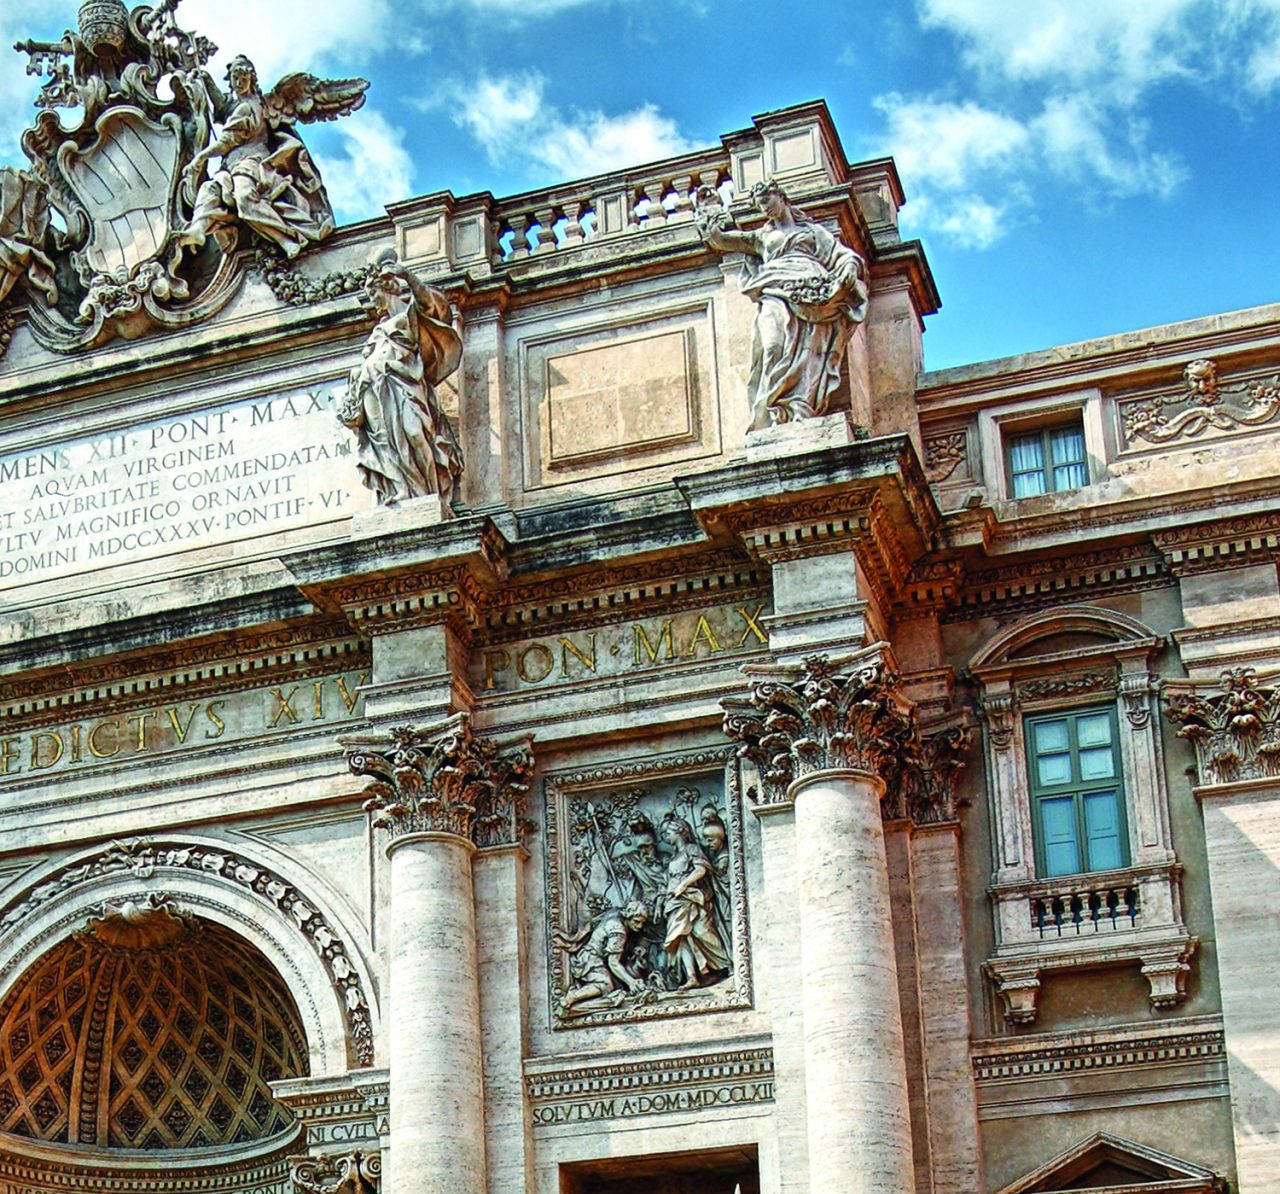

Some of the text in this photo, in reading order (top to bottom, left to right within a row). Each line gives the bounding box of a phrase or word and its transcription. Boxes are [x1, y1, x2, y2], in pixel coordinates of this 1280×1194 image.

[23, 480, 160, 525] SALVBRITATE
[172, 438, 353, 491] COMMENDATAM
[30, 440, 235, 500] AQVAM VIRGINEM
[56, 500, 180, 542] MAGNIFICO
[192, 474, 296, 512] ORNAVIT
[0, 546, 77, 578] DOMINI
[632, 603, 769, 666] MAX
[267, 673, 369, 728] XIV
[533, 1099, 616, 1124] SOLVTVM
